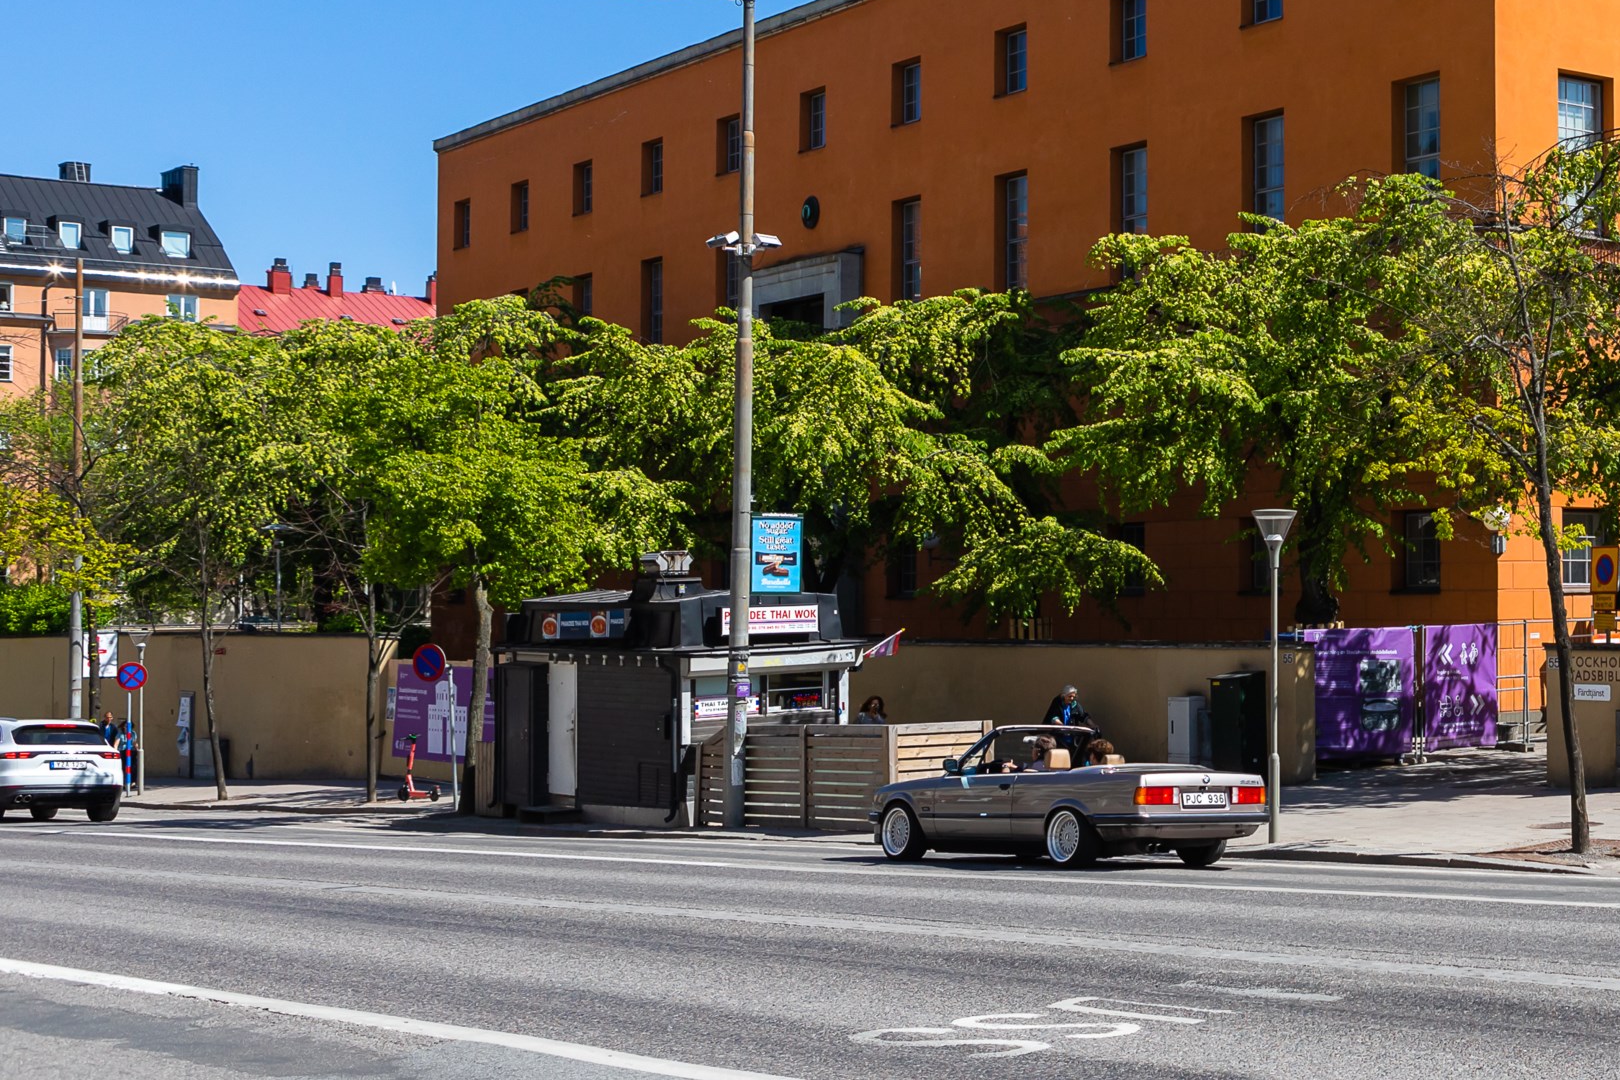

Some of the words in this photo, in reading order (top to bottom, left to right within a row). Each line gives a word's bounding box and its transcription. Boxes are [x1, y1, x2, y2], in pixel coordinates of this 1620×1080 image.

[724, 610, 767, 620] PDEE
[770, 610, 791, 619] THAI
[794, 609, 817, 618] WOK
[1283, 654, 1293, 663] 55
[1577, 687, 1605, 698] Färdtjänst
[1185, 794, 1202, 804] PJC
[1208, 794, 1224, 803] 936
[850, 982, 1342, 1058] USS
